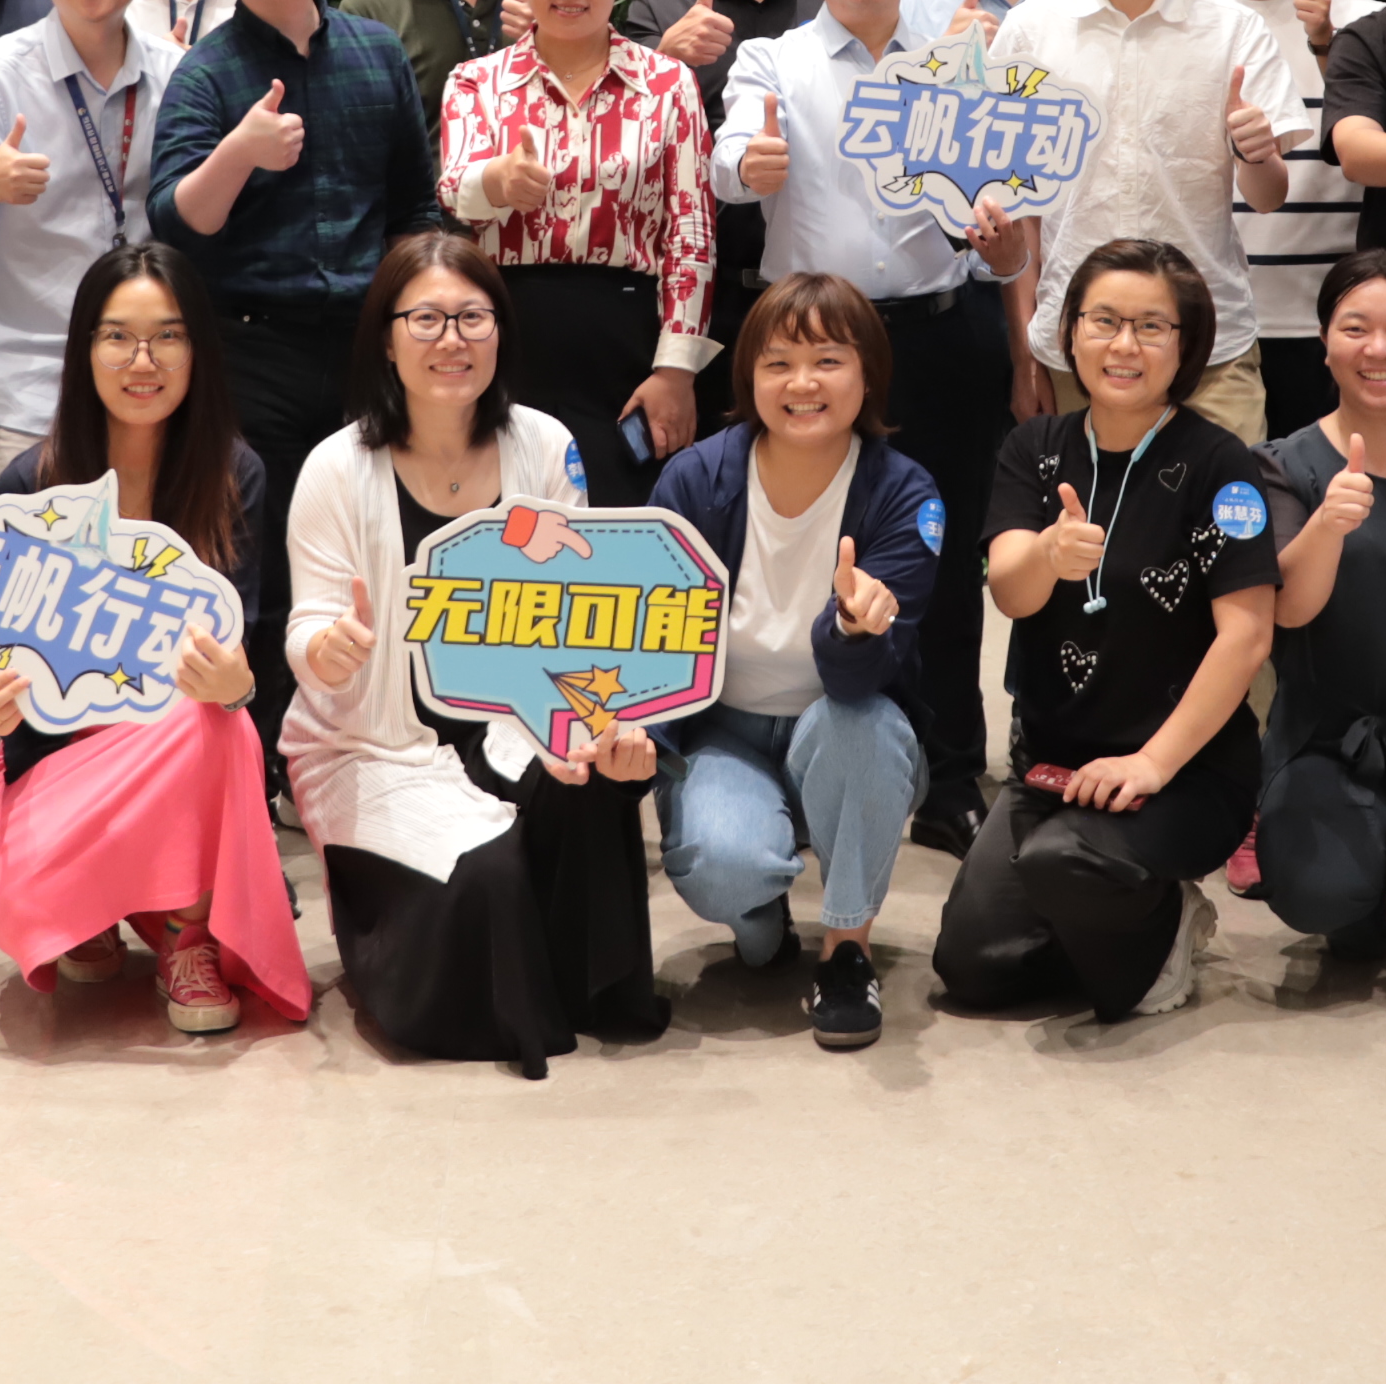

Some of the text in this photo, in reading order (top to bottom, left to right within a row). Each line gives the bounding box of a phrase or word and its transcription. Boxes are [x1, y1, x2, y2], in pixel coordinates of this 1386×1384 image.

[843, 84, 1087, 178] 云帆行动
[404, 576, 719, 654] 无限可能
